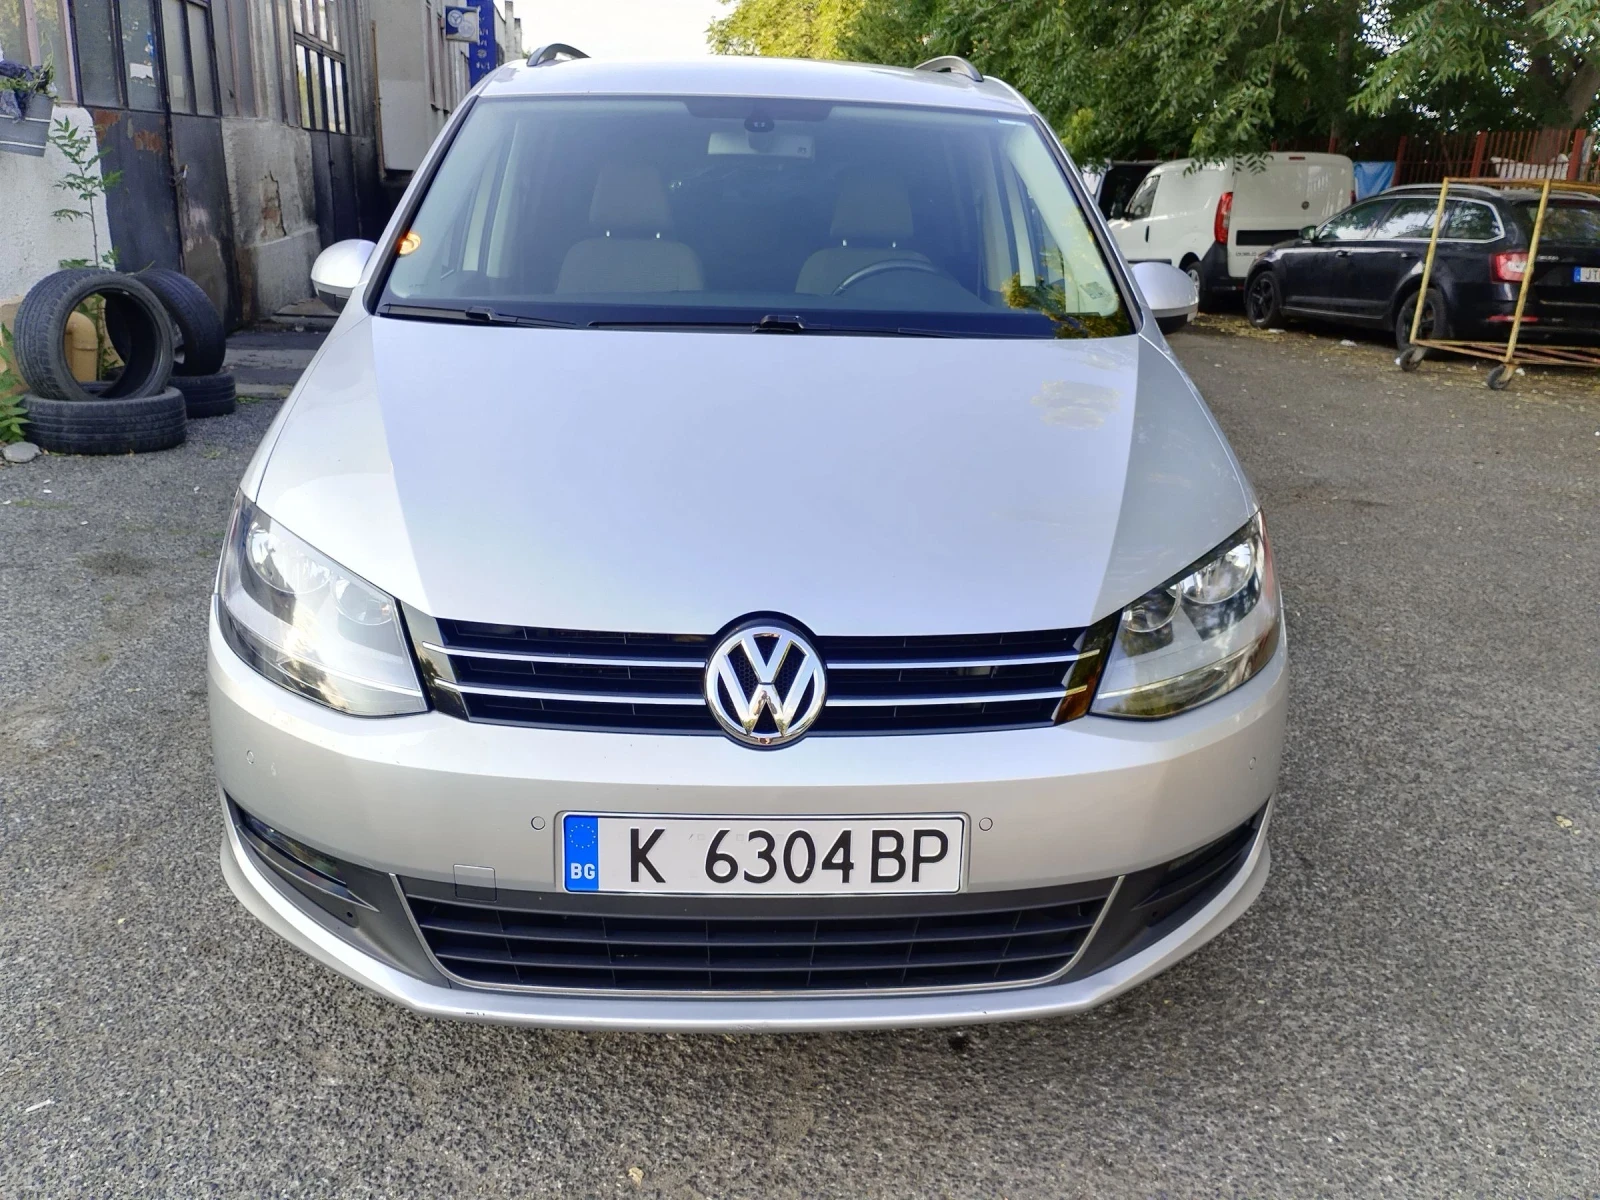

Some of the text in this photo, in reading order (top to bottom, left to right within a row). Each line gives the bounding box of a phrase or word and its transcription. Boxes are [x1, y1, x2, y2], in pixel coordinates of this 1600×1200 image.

[570, 862, 596, 880] BG
[630, 828, 949, 884] K 6304 BP
